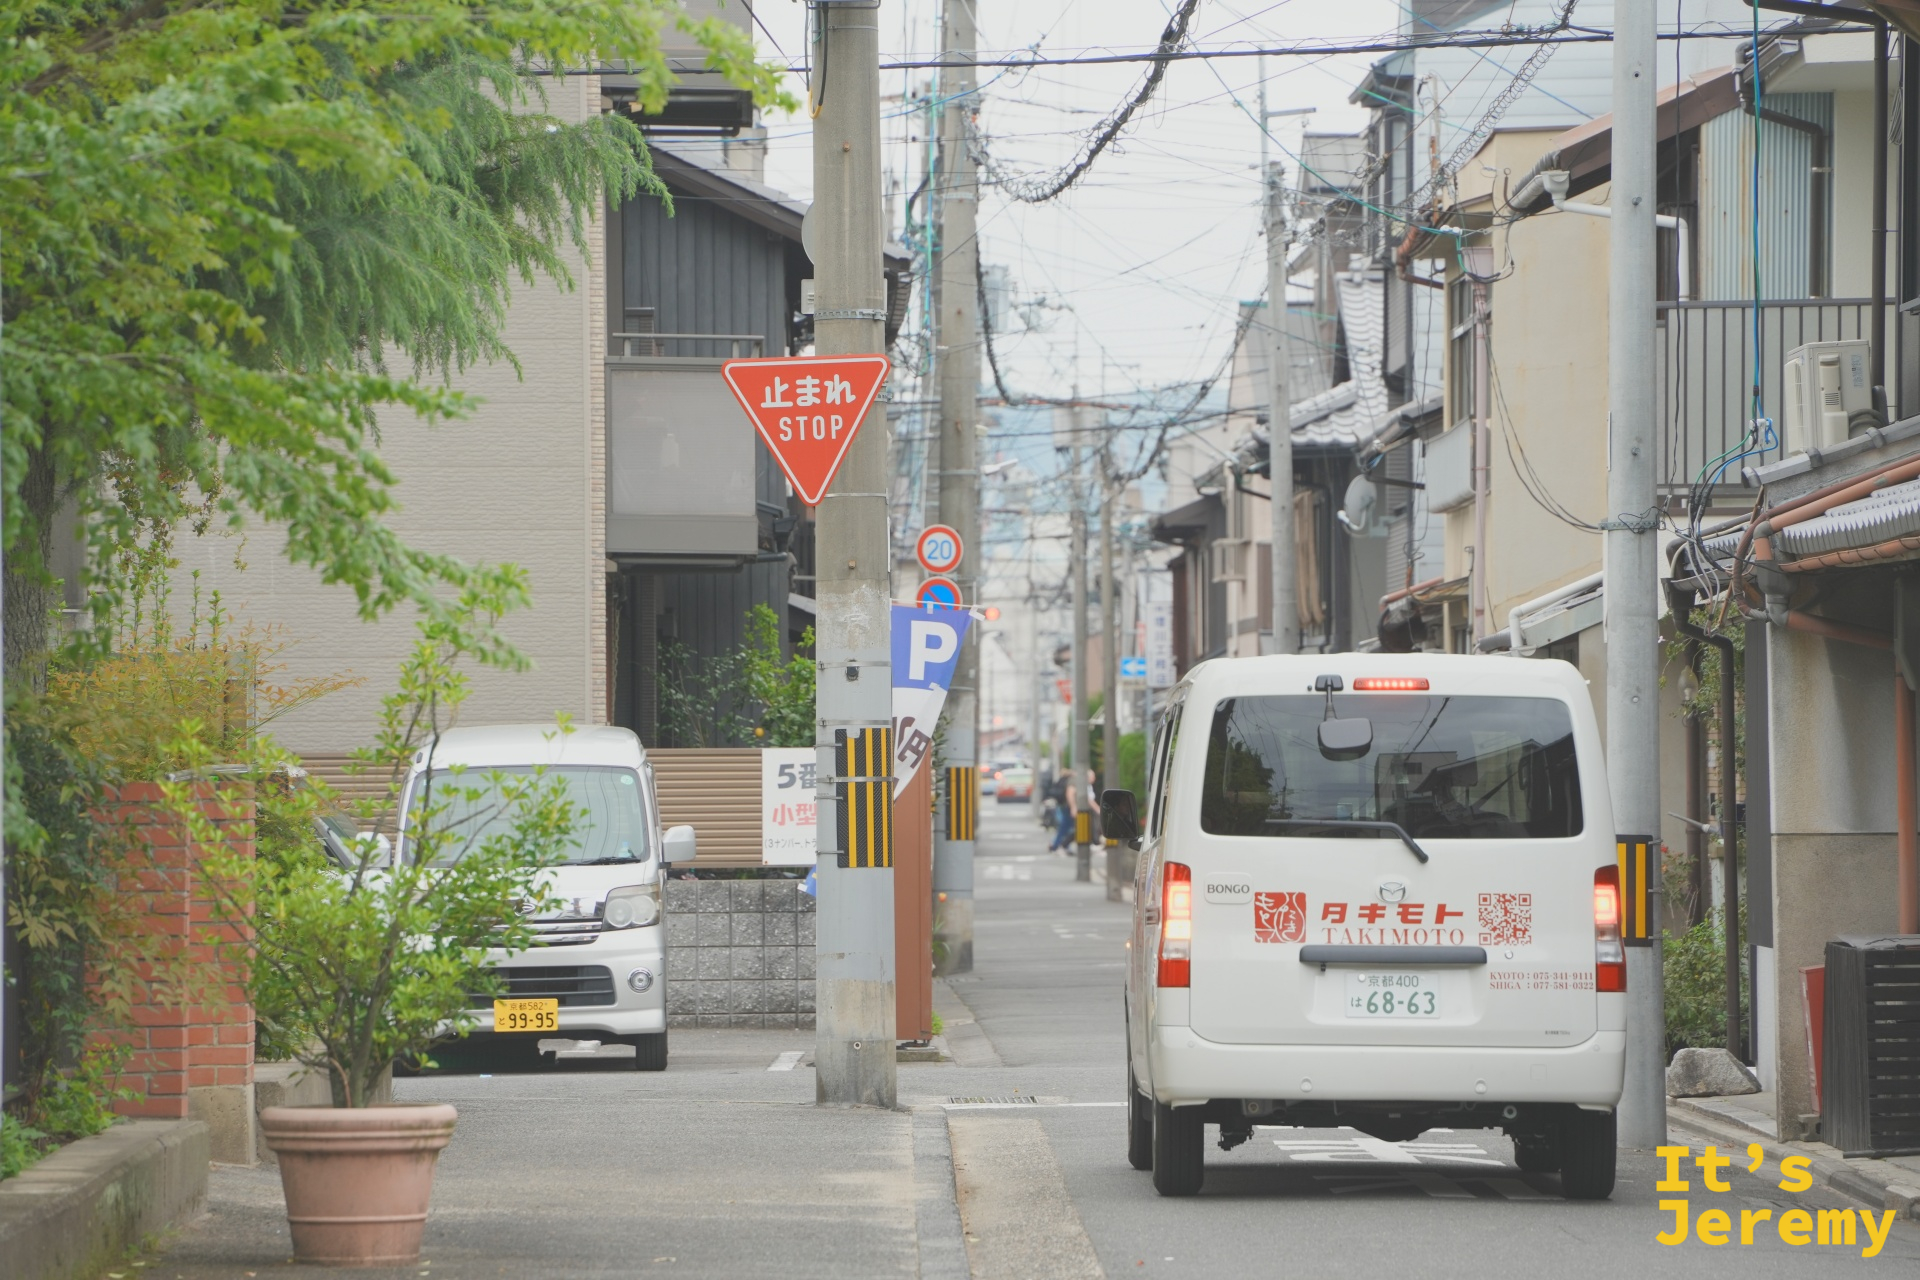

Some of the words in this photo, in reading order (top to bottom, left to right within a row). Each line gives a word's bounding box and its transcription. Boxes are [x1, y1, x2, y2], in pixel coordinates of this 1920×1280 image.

[761, 374, 856, 408] 止まれ
[779, 414, 843, 441] STOP
[927, 539, 952, 560] 20
[908, 620, 958, 681] P
[1207, 884, 1250, 894] BONGO
[1321, 902, 1464, 924] タキモト
[1321, 927, 1464, 945] TAKIMOTO
[1367, 991, 1435, 1014] 68-63
[509, 1012, 554, 1028] 99-95
